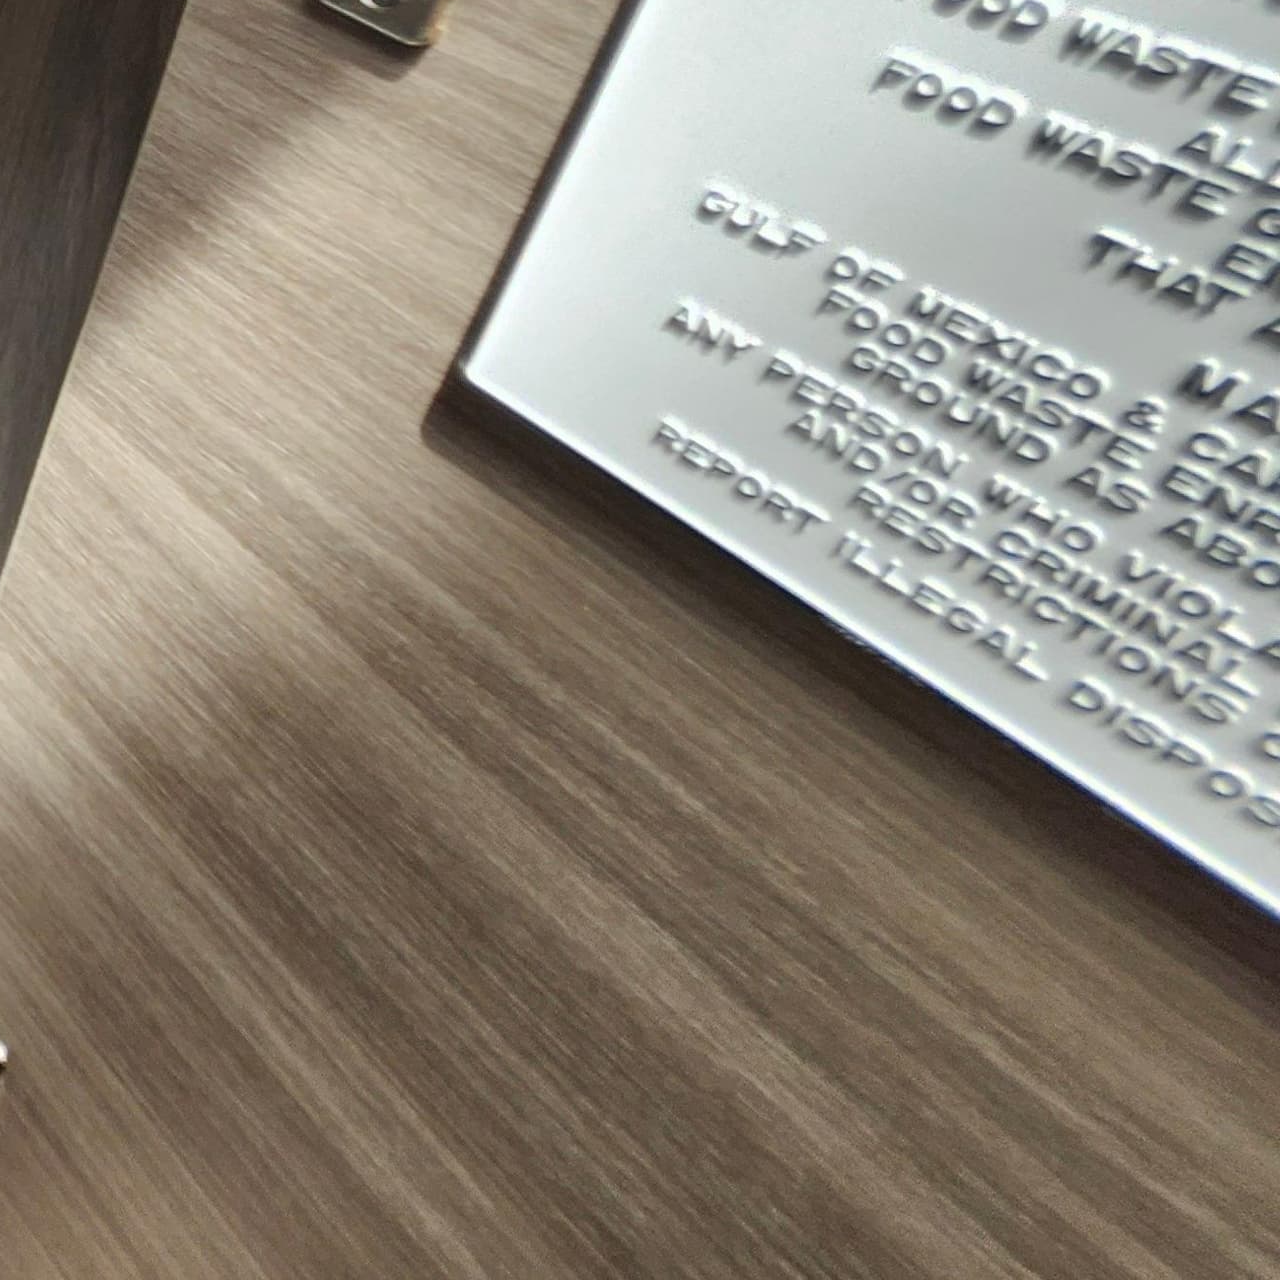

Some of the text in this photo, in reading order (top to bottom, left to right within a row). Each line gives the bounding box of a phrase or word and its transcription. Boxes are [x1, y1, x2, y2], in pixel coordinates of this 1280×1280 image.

[868, 50, 1028, 139] FOOD
[1024, 110, 1240, 222] WASTE
[1058, 8, 1280, 113] WASTE
[695, 180, 828, 258] GULF
[825, 248, 907, 294] OF
[905, 283, 1110, 402] MEXICO
[1122, 394, 1167, 436] &
[816, 284, 954, 367] FOOD
[963, 358, 1158, 470] WASTE
[1085, 226, 1252, 320] THAT
[663, 295, 764, 363] ANY
[758, 348, 971, 481] PERSON
[983, 472, 1105, 554] WHO
[842, 344, 1055, 466] GROUND
[1062, 464, 1152, 514] AS
[649, 412, 832, 536] REPORT
[831, 528, 1049, 682] ILLEGAL
[785, 409, 1262, 700] AND/OR CRIMINAL
[845, 479, 1252, 725] RESTRICTIONS
